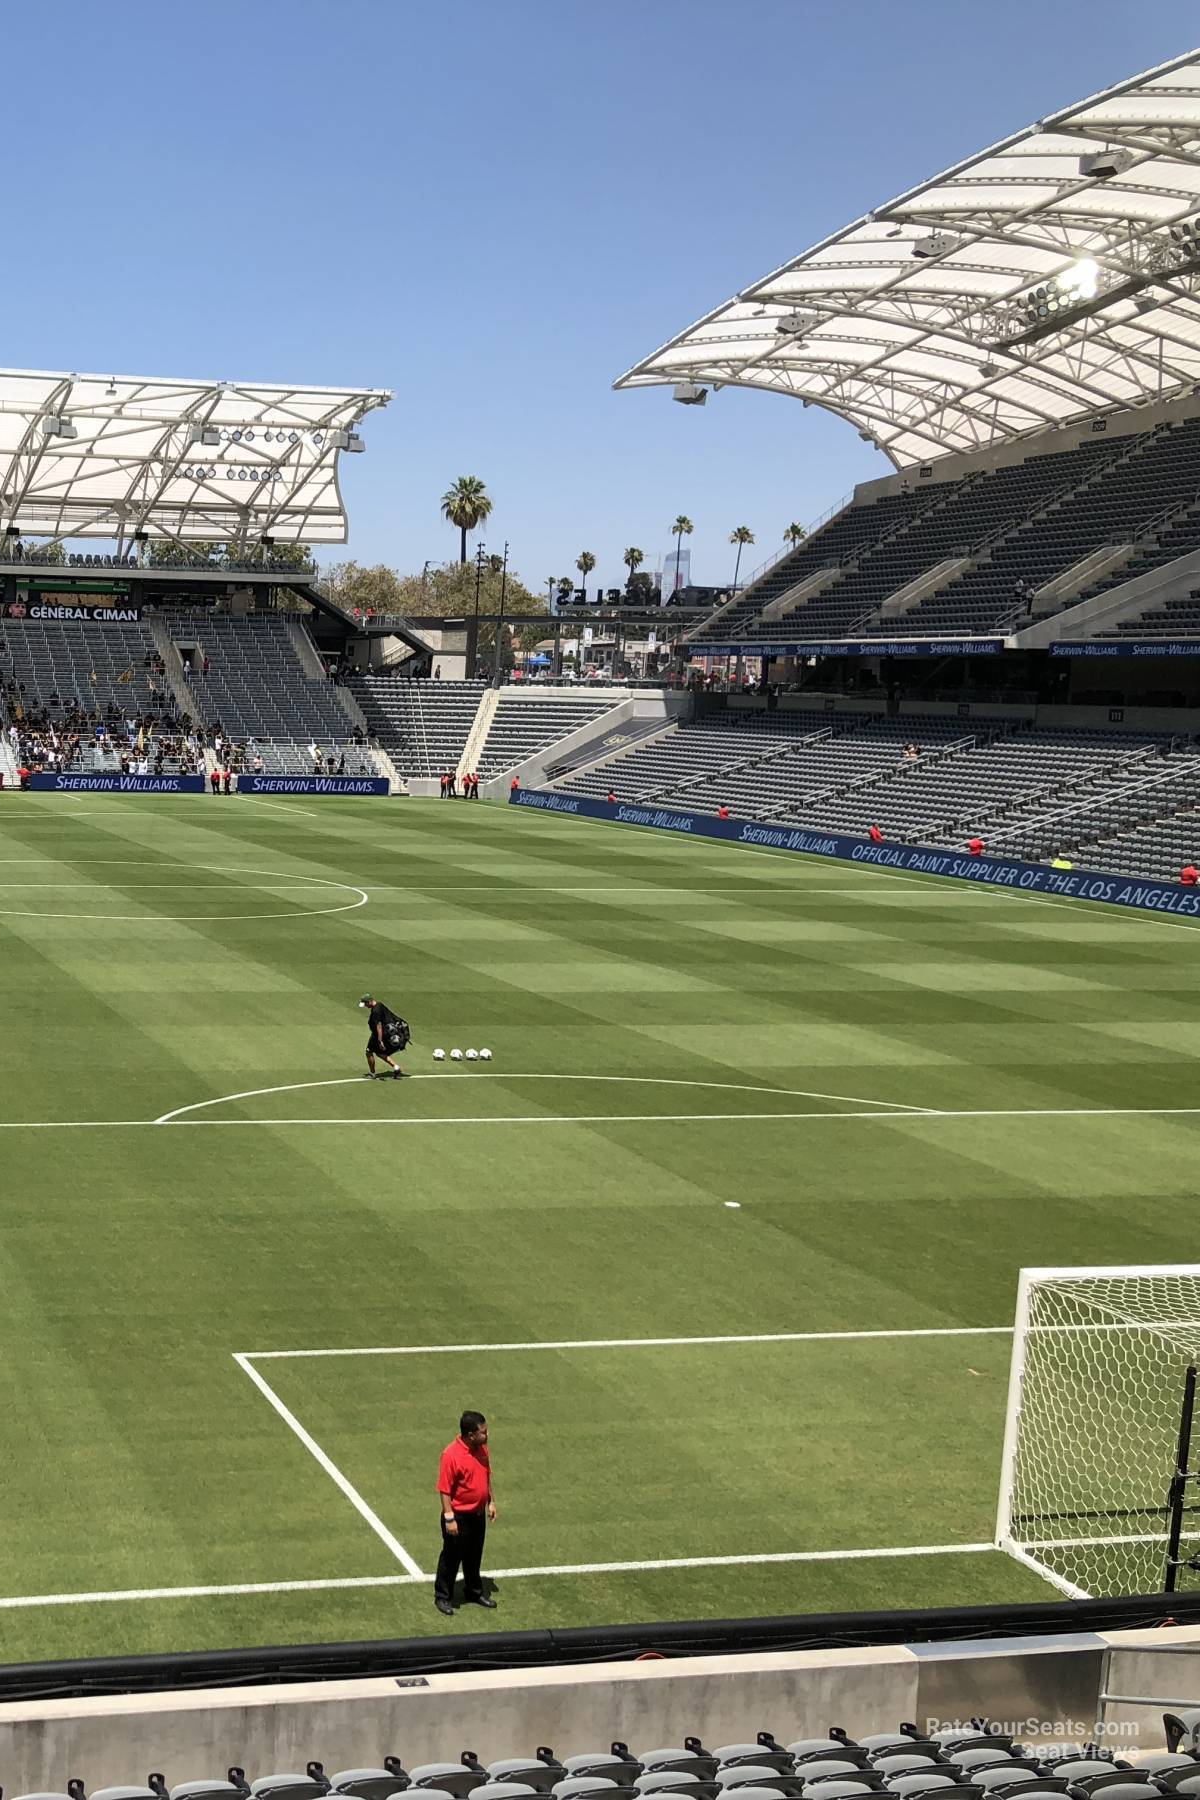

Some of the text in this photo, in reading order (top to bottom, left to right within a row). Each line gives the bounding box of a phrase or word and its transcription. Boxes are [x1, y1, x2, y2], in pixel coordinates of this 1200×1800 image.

[93, 608, 138, 621] CIMAN
[858, 643, 917, 655] SHERWIN-WILLIAMS
[929, 642, 997, 654] SHERWIN-WILLIAMS
[1052, 645, 1118, 656] SHERWIN-WILLIAMS
[55, 775, 181, 791] SHERWIN-WILLIAMS
[252, 777, 375, 792] SHERWIN-WILLIAMS
[516, 790, 579, 813] SHERWIN-WILLIAMS
[615, 805, 693, 832] SHERWIN-WILLIAMS
[739, 824, 839, 855] SHERWIN-WILLIAMS
[851, 843, 903, 867] OFFICIAL
[906, 852, 950, 873] PAINT
[948, 859, 1016, 885] SUPPLIER
[1019, 870, 1043, 888] OF
[1079, 879, 1116, 901] LOS
[1115, 886, 1200, 914] ANGELES
